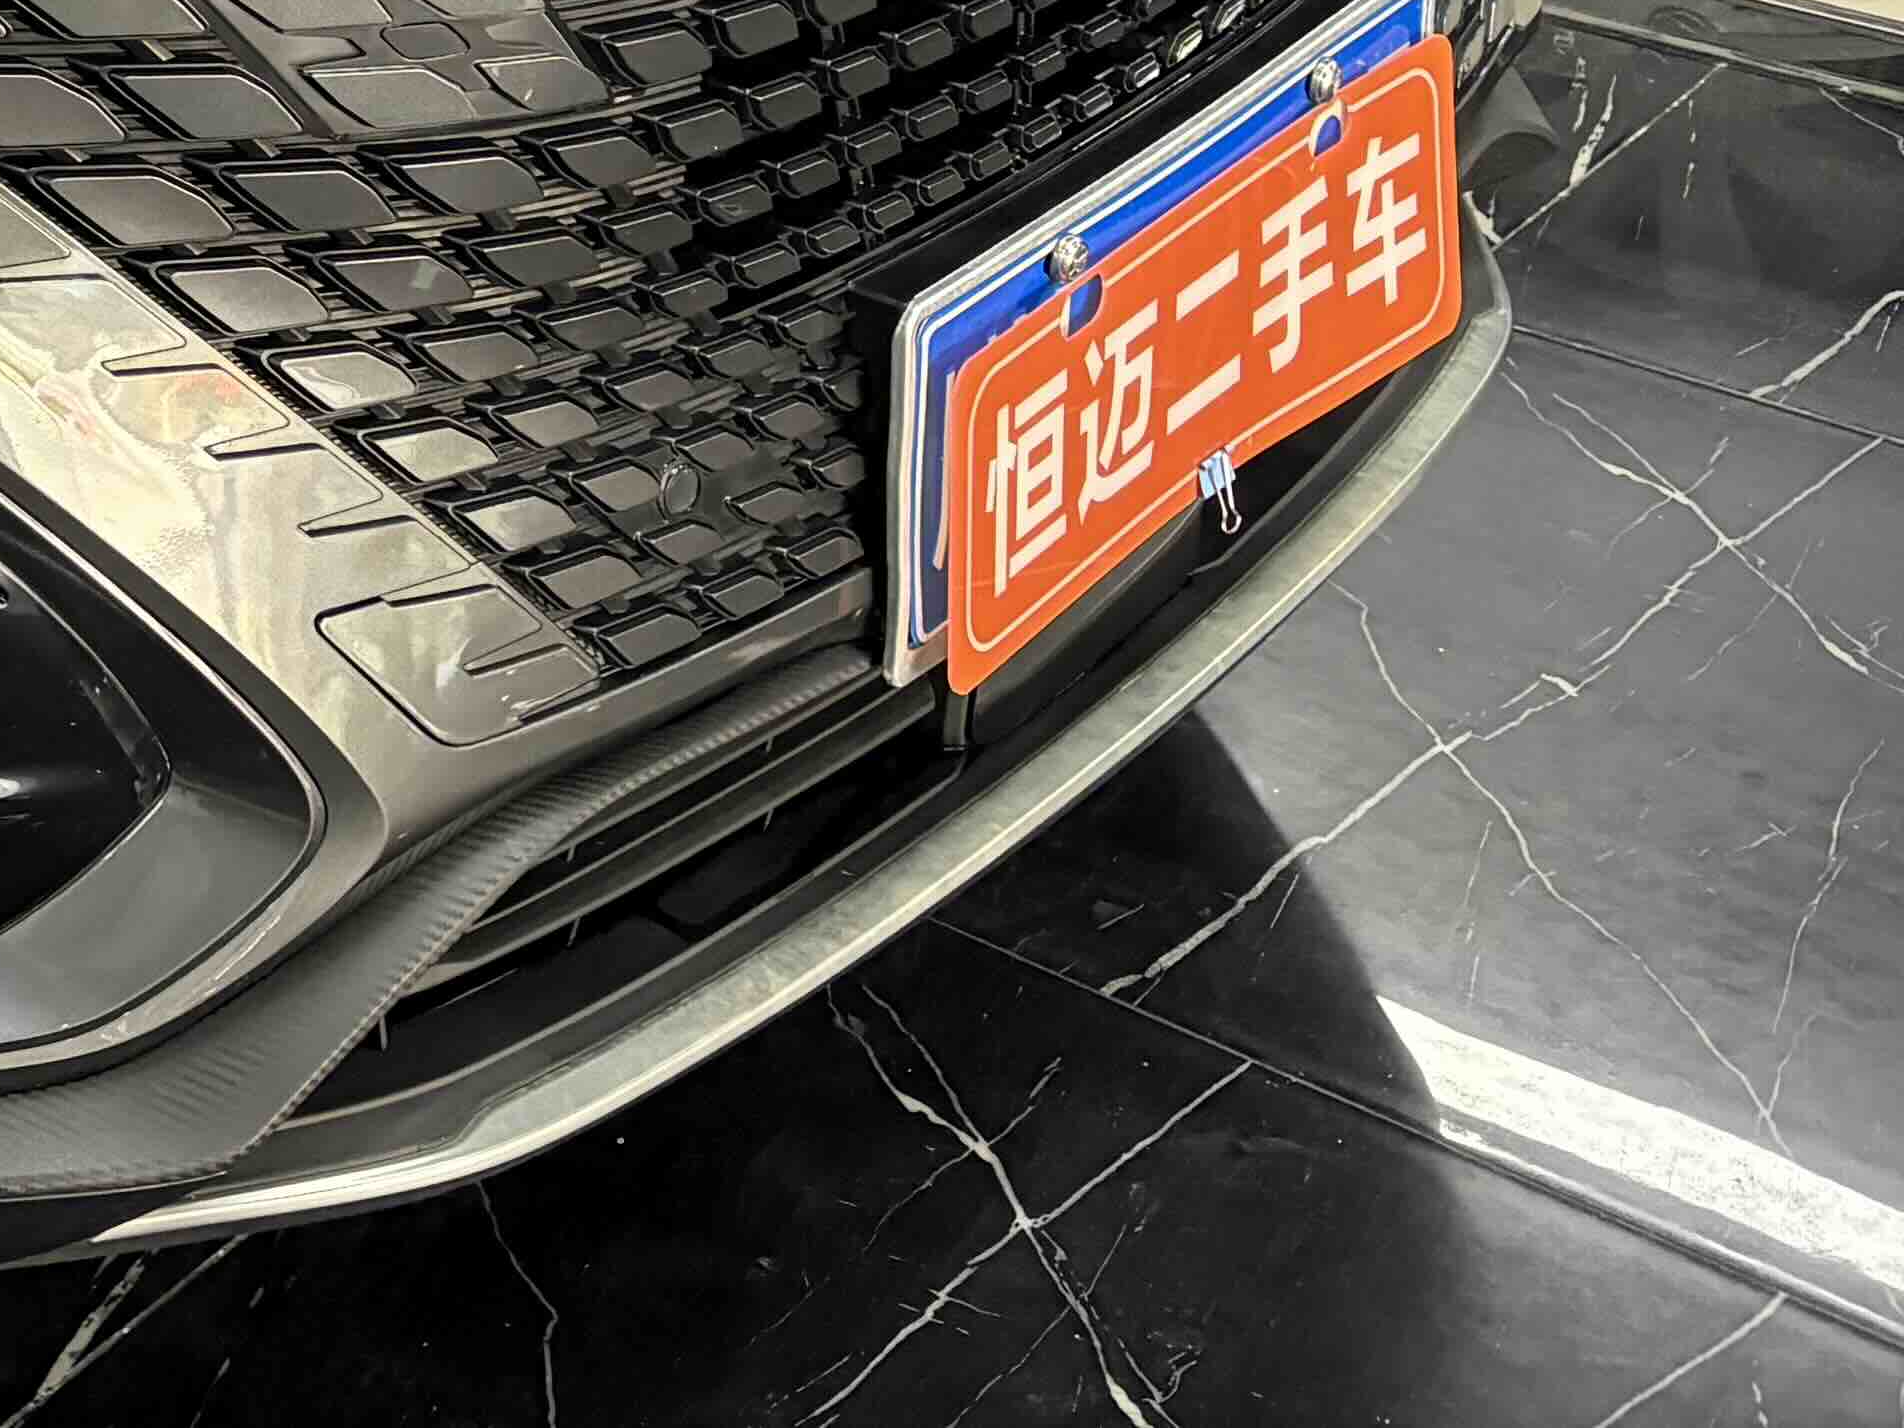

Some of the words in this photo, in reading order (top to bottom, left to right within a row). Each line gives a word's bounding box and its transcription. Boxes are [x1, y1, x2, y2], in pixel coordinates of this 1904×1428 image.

[985, 131, 1428, 598] 恒迈二手车
